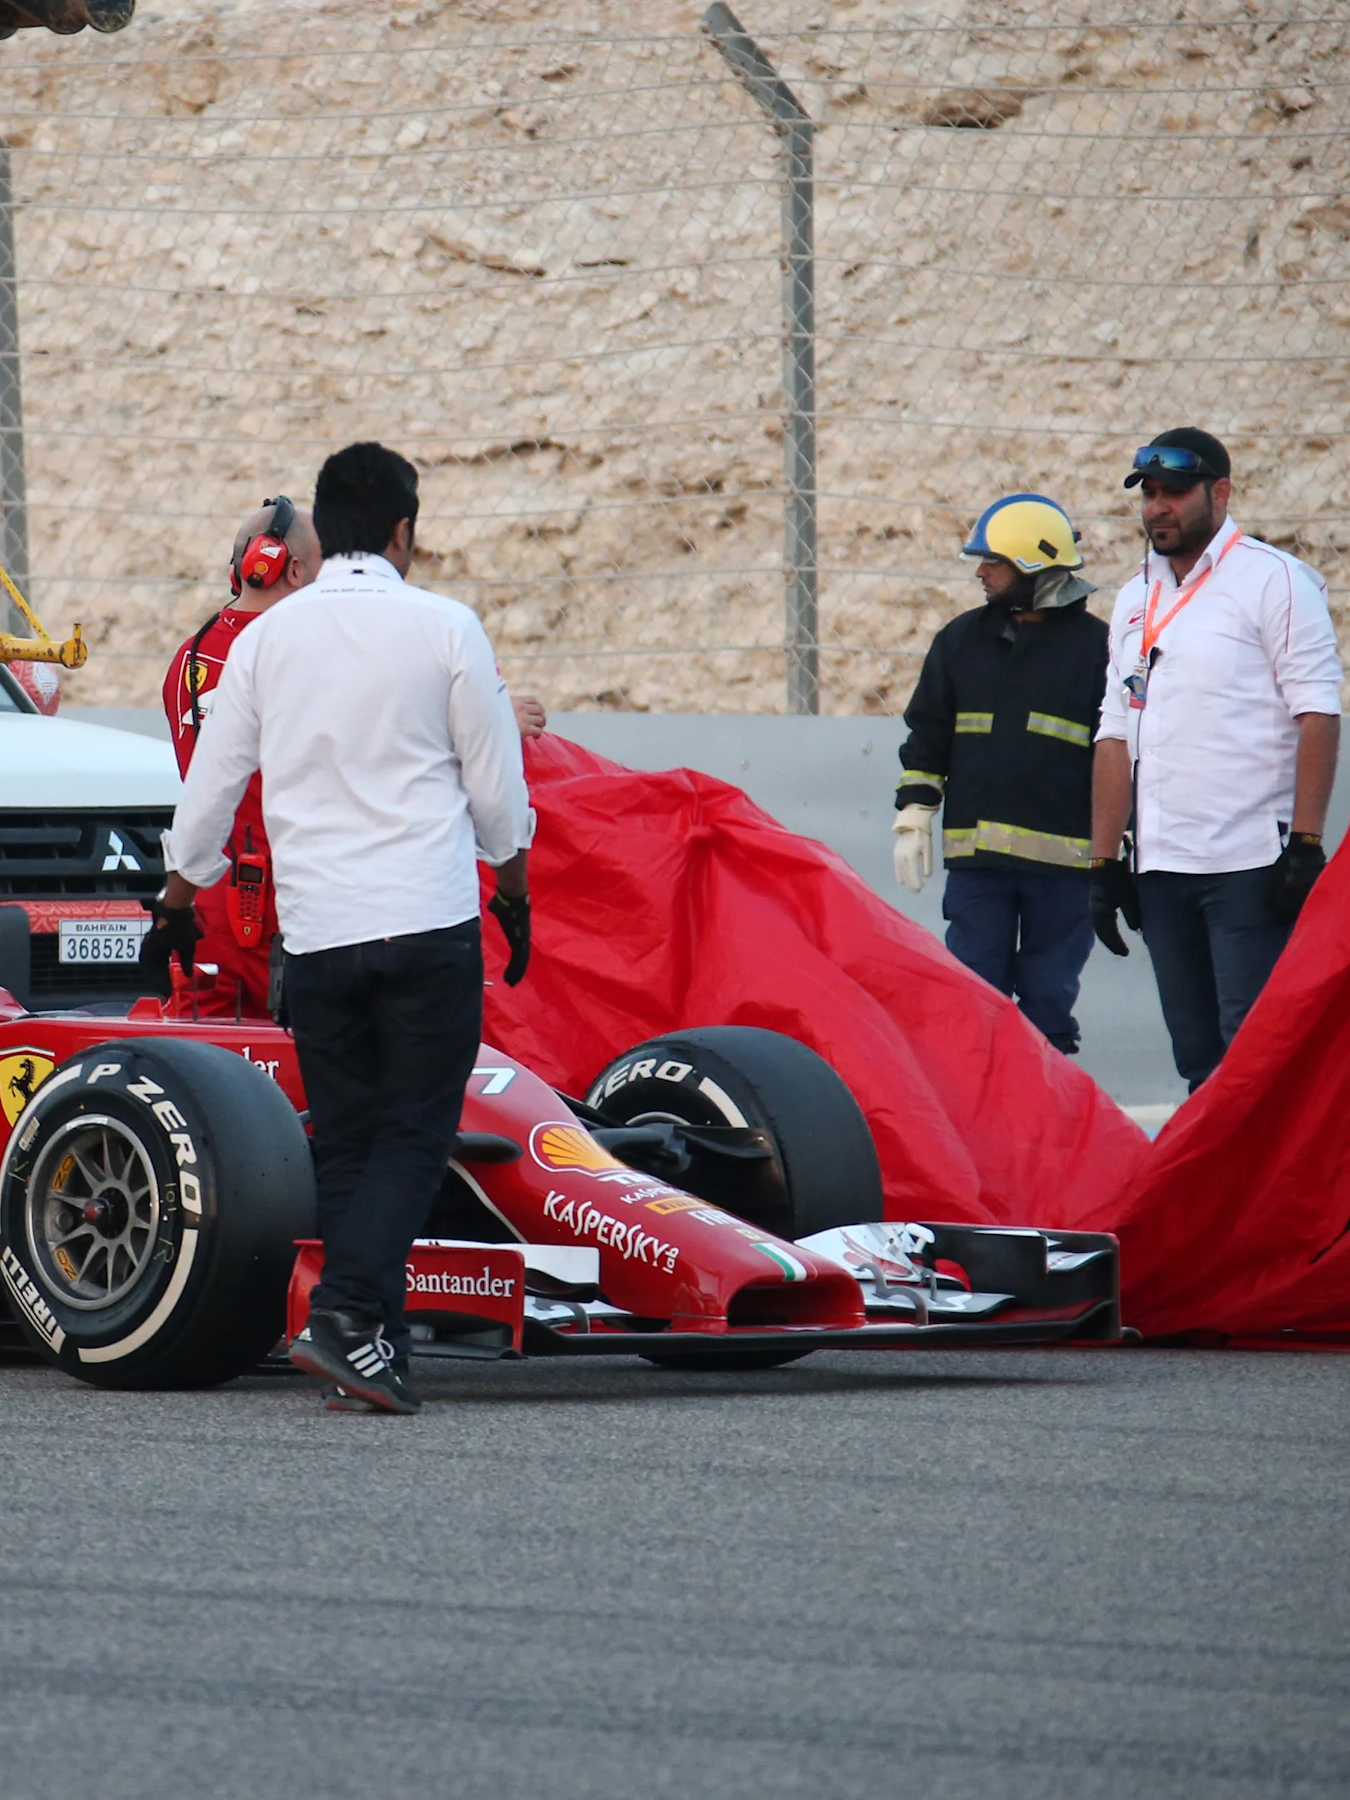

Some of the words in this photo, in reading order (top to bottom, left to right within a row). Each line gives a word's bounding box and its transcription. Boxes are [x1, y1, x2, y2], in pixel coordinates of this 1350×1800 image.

[75, 923, 128, 932] BAHRAIN
[67, 937, 136, 960] 368525
[472, 1067, 517, 1095] 7
[86, 1063, 122, 1085] P
[125, 1075, 203, 1215] ZERO
[543, 1189, 670, 1267] KASPERSKY
[661, 1247, 680, 1275] lab
[405, 1263, 516, 1298] Santander
[0, 1245, 67, 1355] PIRELLI
